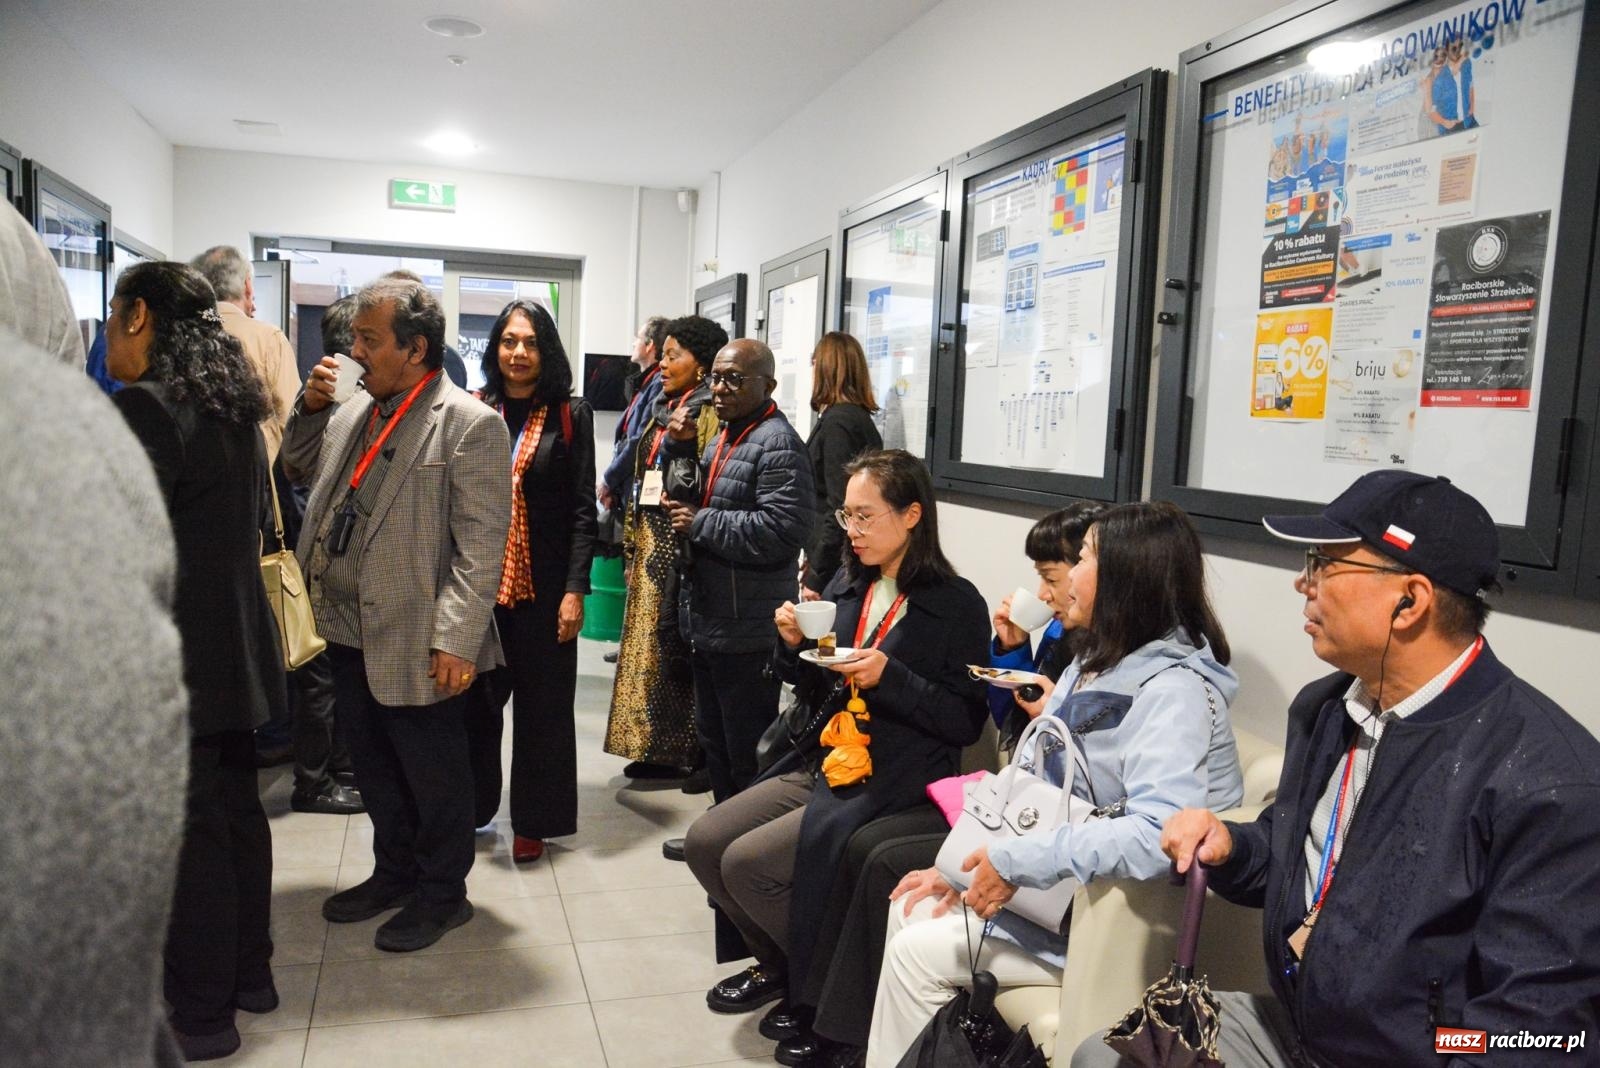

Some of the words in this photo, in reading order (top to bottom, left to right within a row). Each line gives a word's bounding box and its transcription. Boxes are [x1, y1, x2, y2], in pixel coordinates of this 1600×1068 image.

[1234, 71, 1308, 117] BENEFITY
[1022, 158, 1050, 182] KADRY
[1274, 240, 1284, 251] 10
[1294, 233, 1326, 247] rabatu
[1435, 289, 1489, 303] Stowarzyszenie
[1490, 285, 1534, 297] Strzeleckie
[1461, 279, 1505, 291] Raciborskie
[1278, 336, 1329, 379] 6%
[1355, 360, 1386, 380] briju
